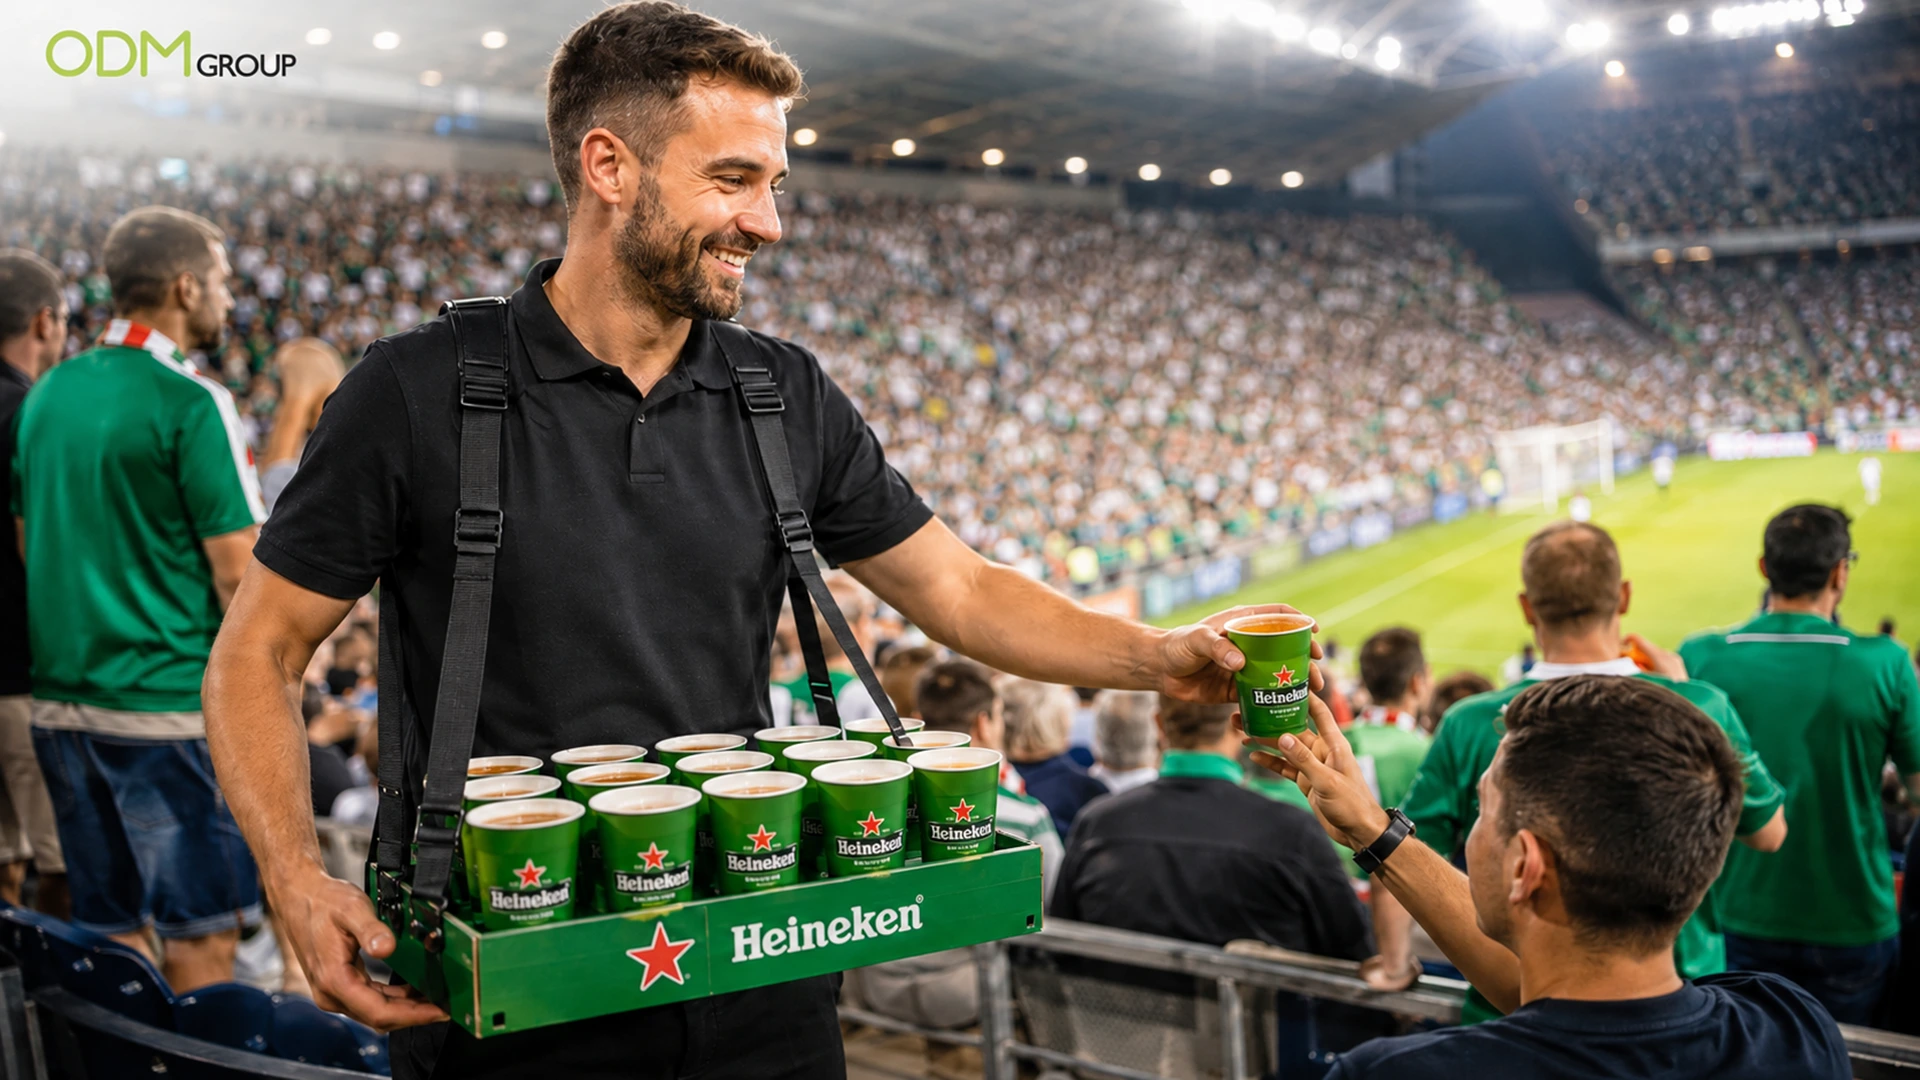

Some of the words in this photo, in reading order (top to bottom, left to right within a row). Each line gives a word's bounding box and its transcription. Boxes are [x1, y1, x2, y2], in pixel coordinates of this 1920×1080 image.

[1254, 686, 1308, 705] Heineken
[931, 822, 992, 841] Heineken
[837, 837, 904, 855] Heineken
[727, 850, 796, 872] Heineken
[616, 869, 690, 891] Heineken
[490, 887, 570, 910] Heineken
[731, 903, 923, 963] Heineken
